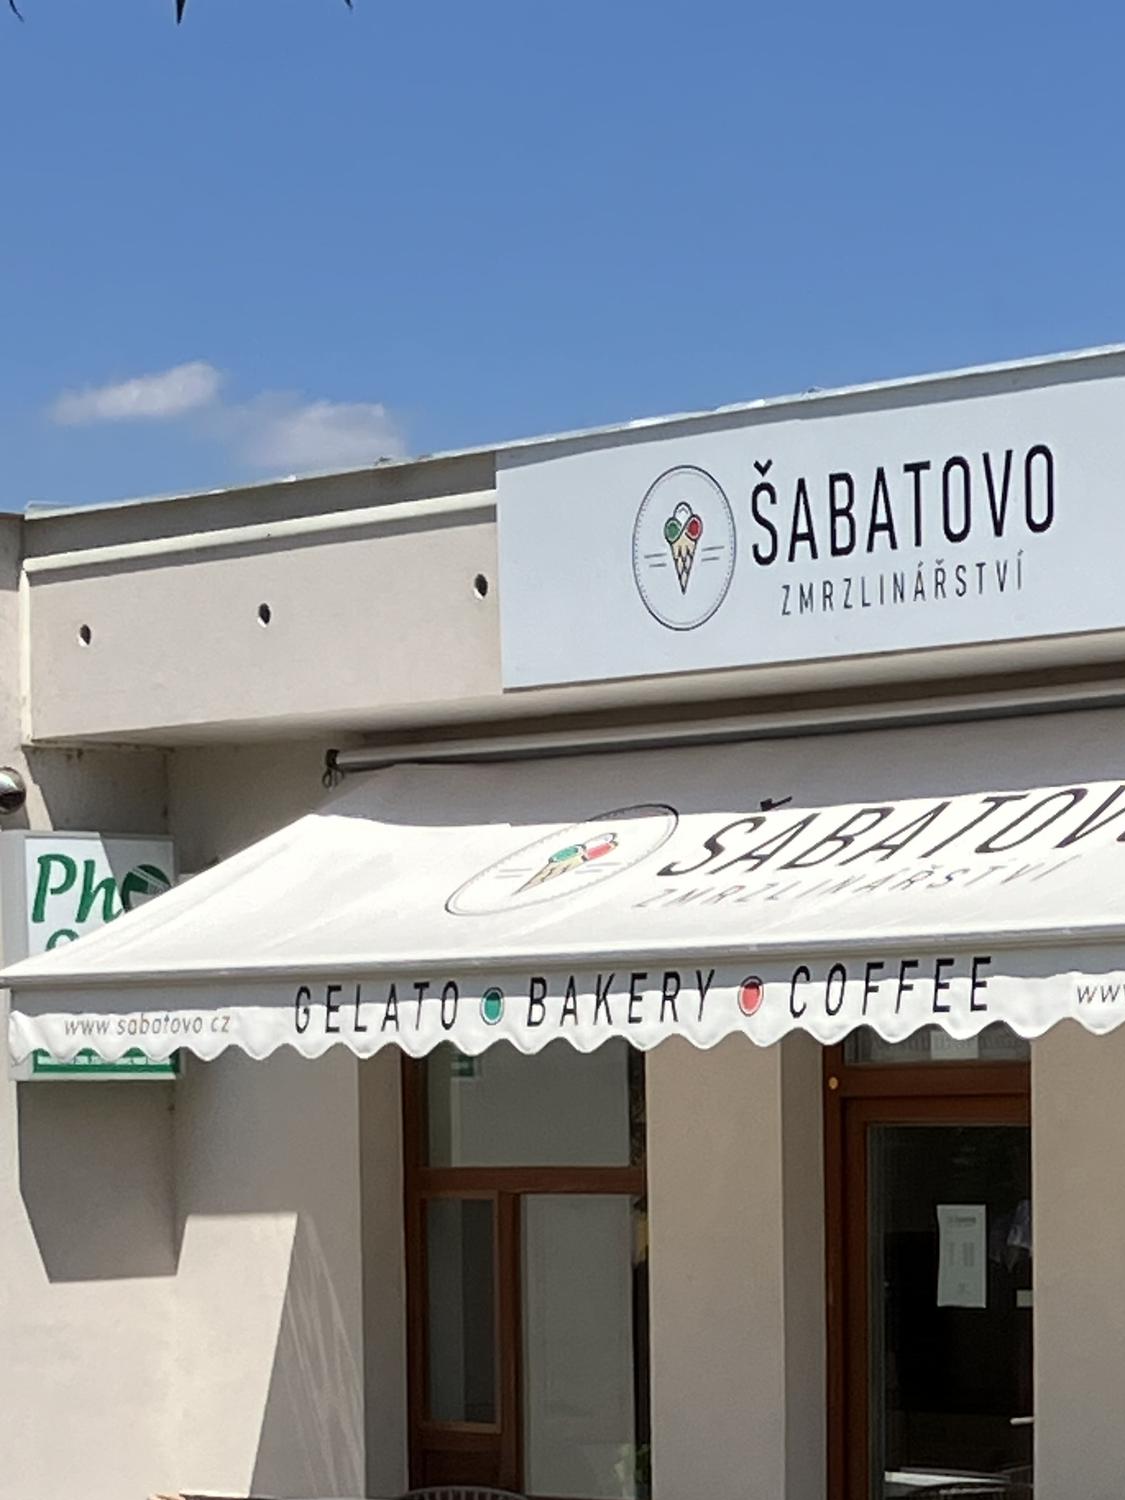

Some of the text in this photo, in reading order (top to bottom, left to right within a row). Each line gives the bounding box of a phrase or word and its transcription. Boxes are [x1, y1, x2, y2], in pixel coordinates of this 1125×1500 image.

[751, 444, 1054, 566] ŠABATOVO
[781, 549, 1024, 616] ZMRZLINÁŘSTVÍ
[64, 1003, 231, 1036] wwwsabatovocz
[295, 956, 992, 1034] GELATO BAKERY COFFEE
